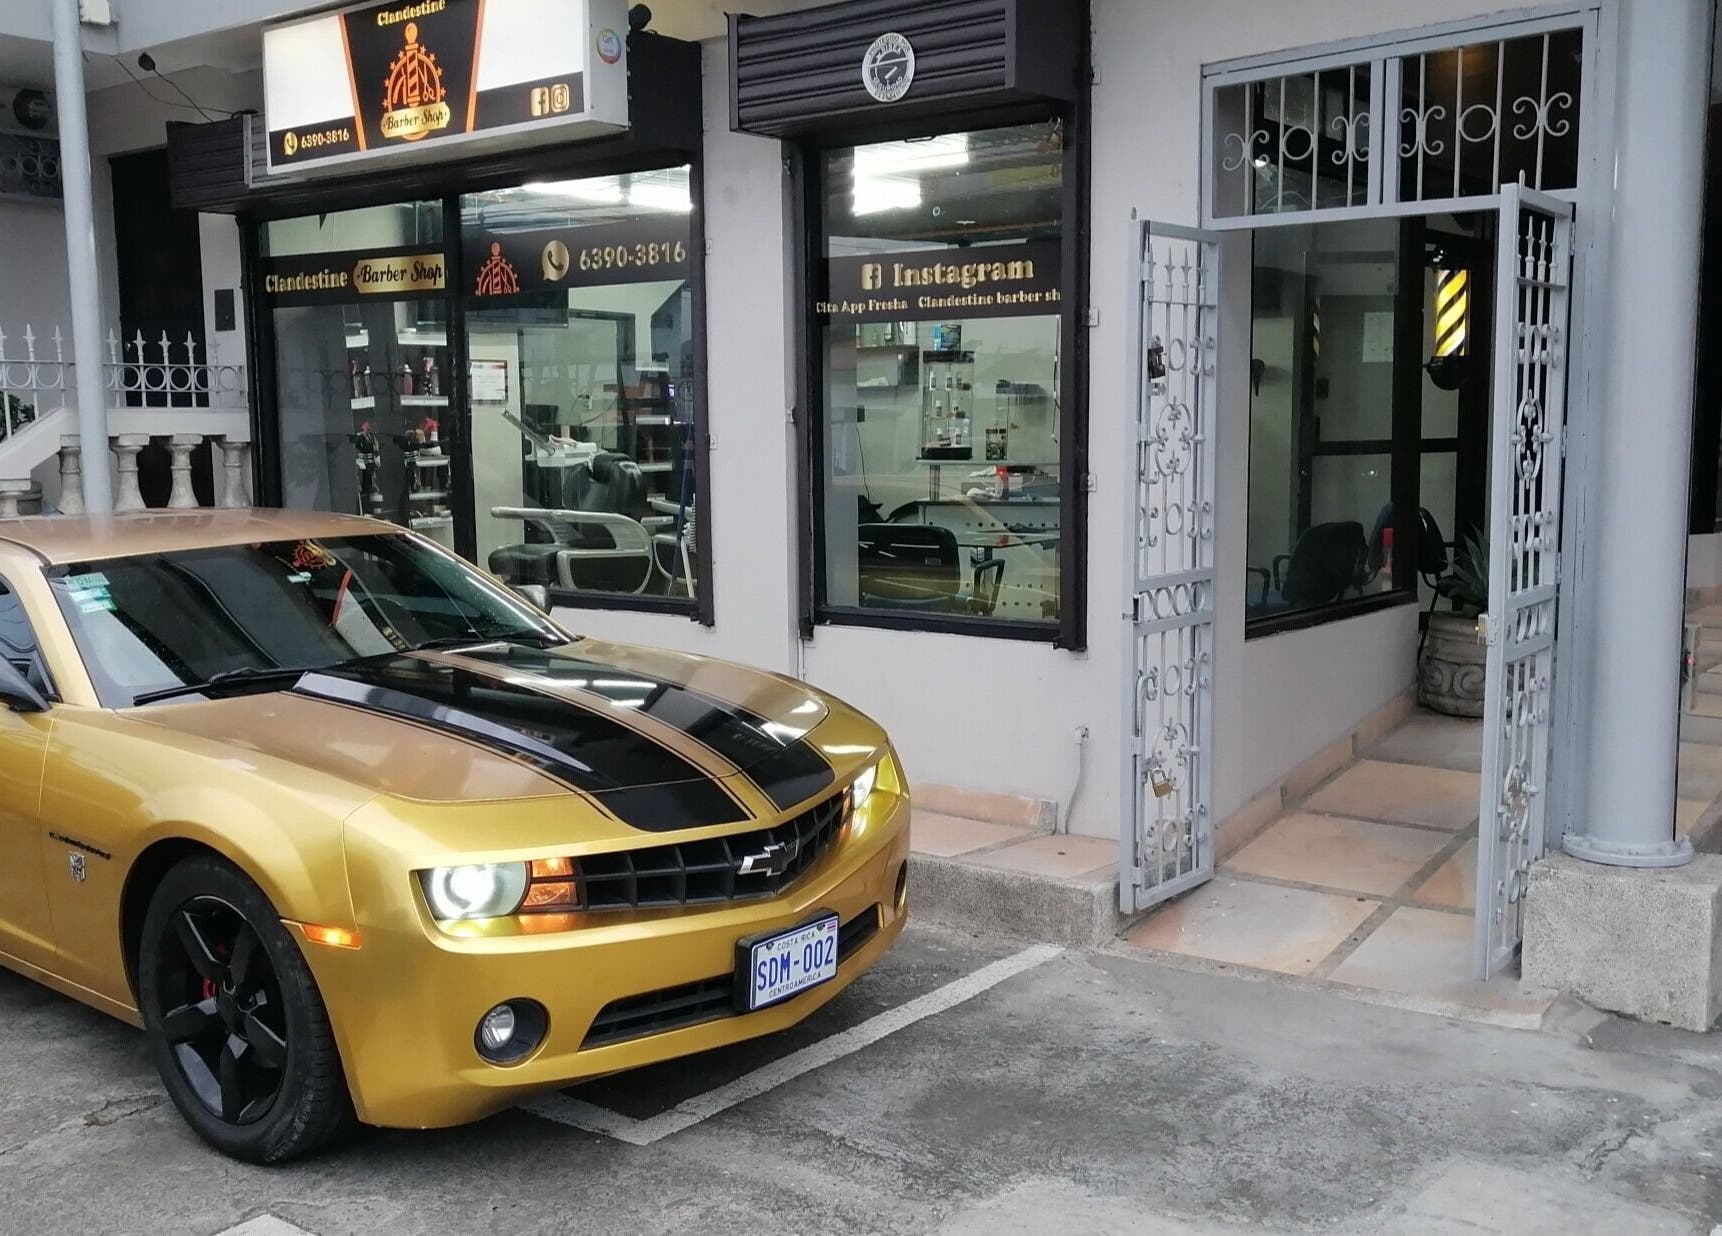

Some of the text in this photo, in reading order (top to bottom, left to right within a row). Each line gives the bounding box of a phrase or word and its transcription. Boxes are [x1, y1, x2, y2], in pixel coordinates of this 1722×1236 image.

[377, 0, 446, 26] Clandestine
[386, 108, 444, 130] Barber Shop
[301, 128, 350, 149] 6390-3816
[579, 241, 687, 271] 6390-3816
[265, 260, 443, 293] Clandestine Barber Shop
[893, 259, 1034, 289] Instagram
[841, 300, 866, 314] App
[868, 297, 908, 311] Fresha
[918, 293, 994, 308] Clandestine
[996, 290, 1042, 304] barber
[777, 931, 816, 951] COSTA RICA
[757, 935, 834, 991] SDM-002
[768, 972, 822, 998] CENTROAMERICA
